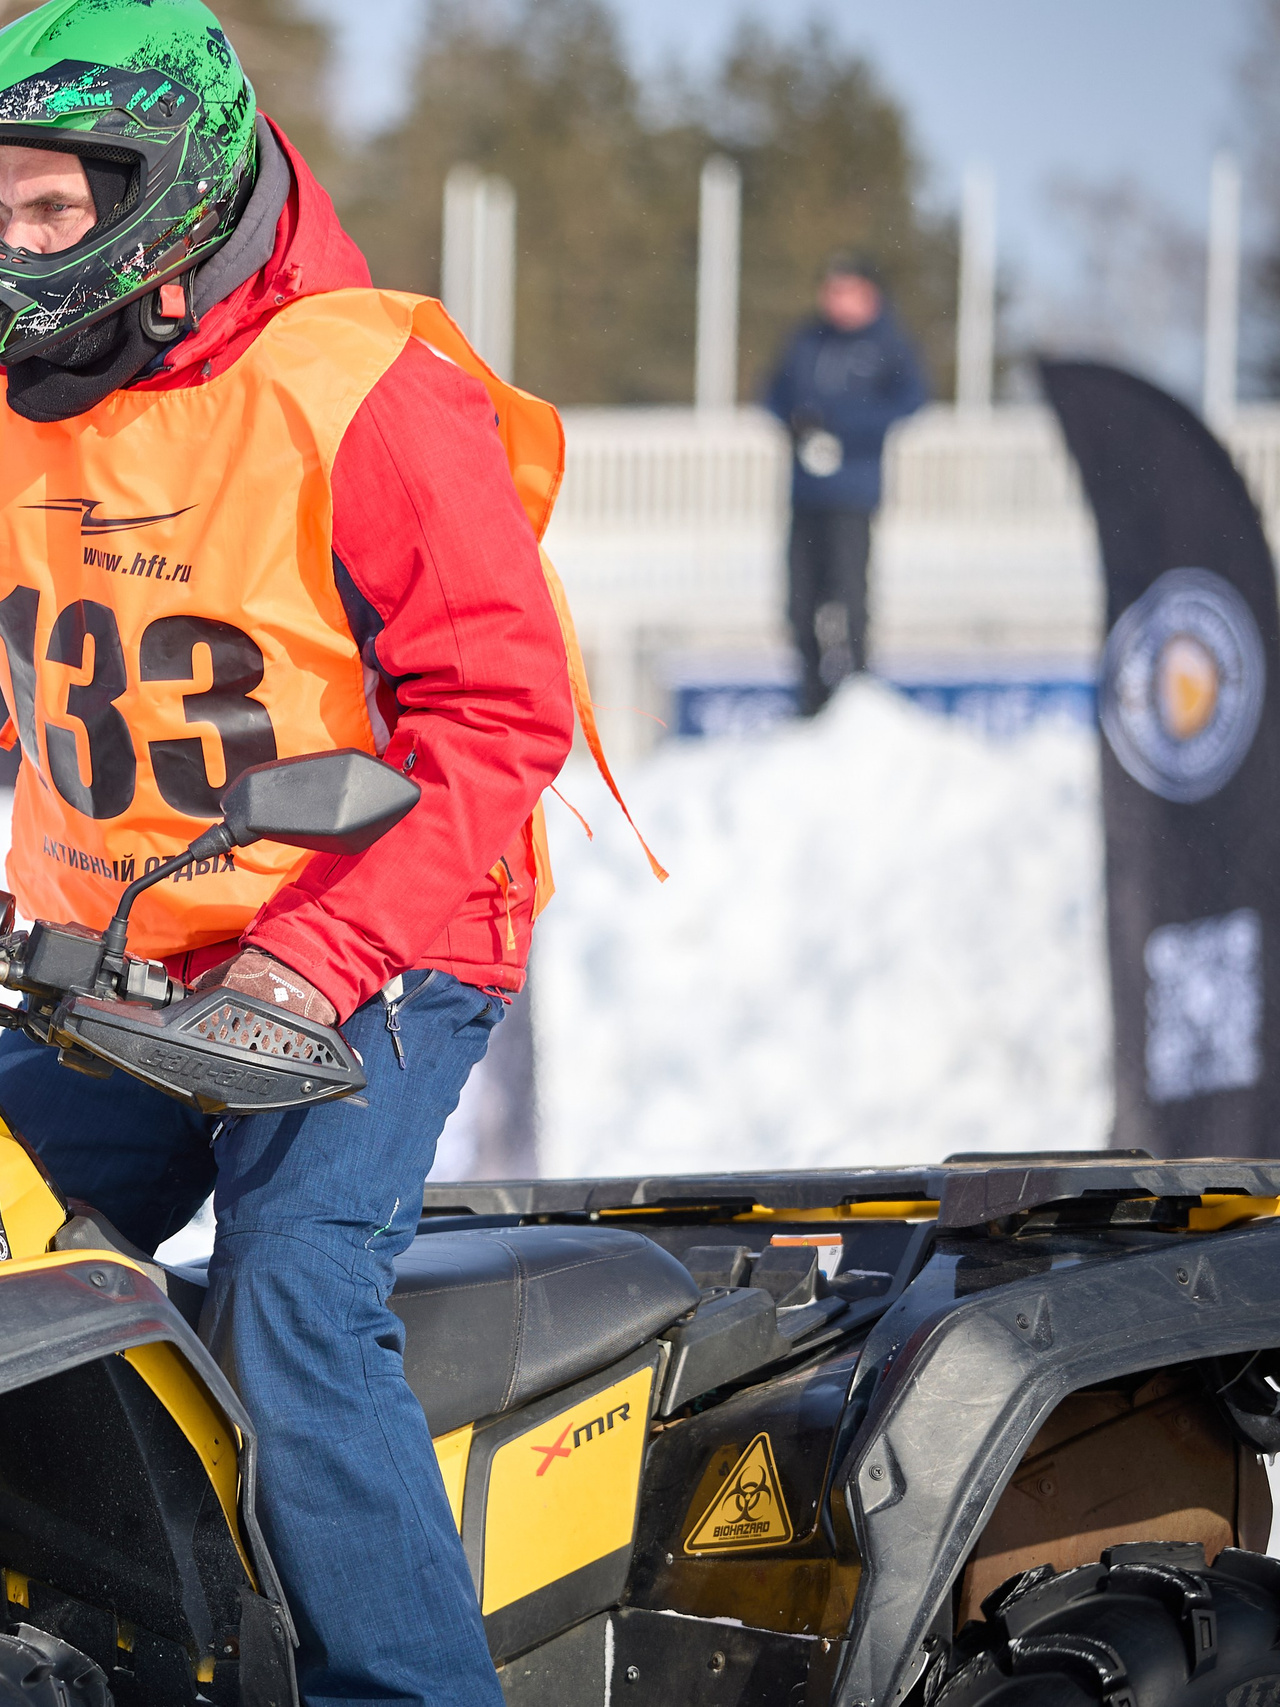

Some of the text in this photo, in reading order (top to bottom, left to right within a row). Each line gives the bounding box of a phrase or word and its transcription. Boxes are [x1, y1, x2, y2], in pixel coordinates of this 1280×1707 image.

[83, 547, 192, 583] www.hft.ru
[43, 834, 135, 882] АКТИВНЫЙ
[138, 1045, 278, 1096] can-am
[713, 1521, 770, 1537] BIOHAZARD
